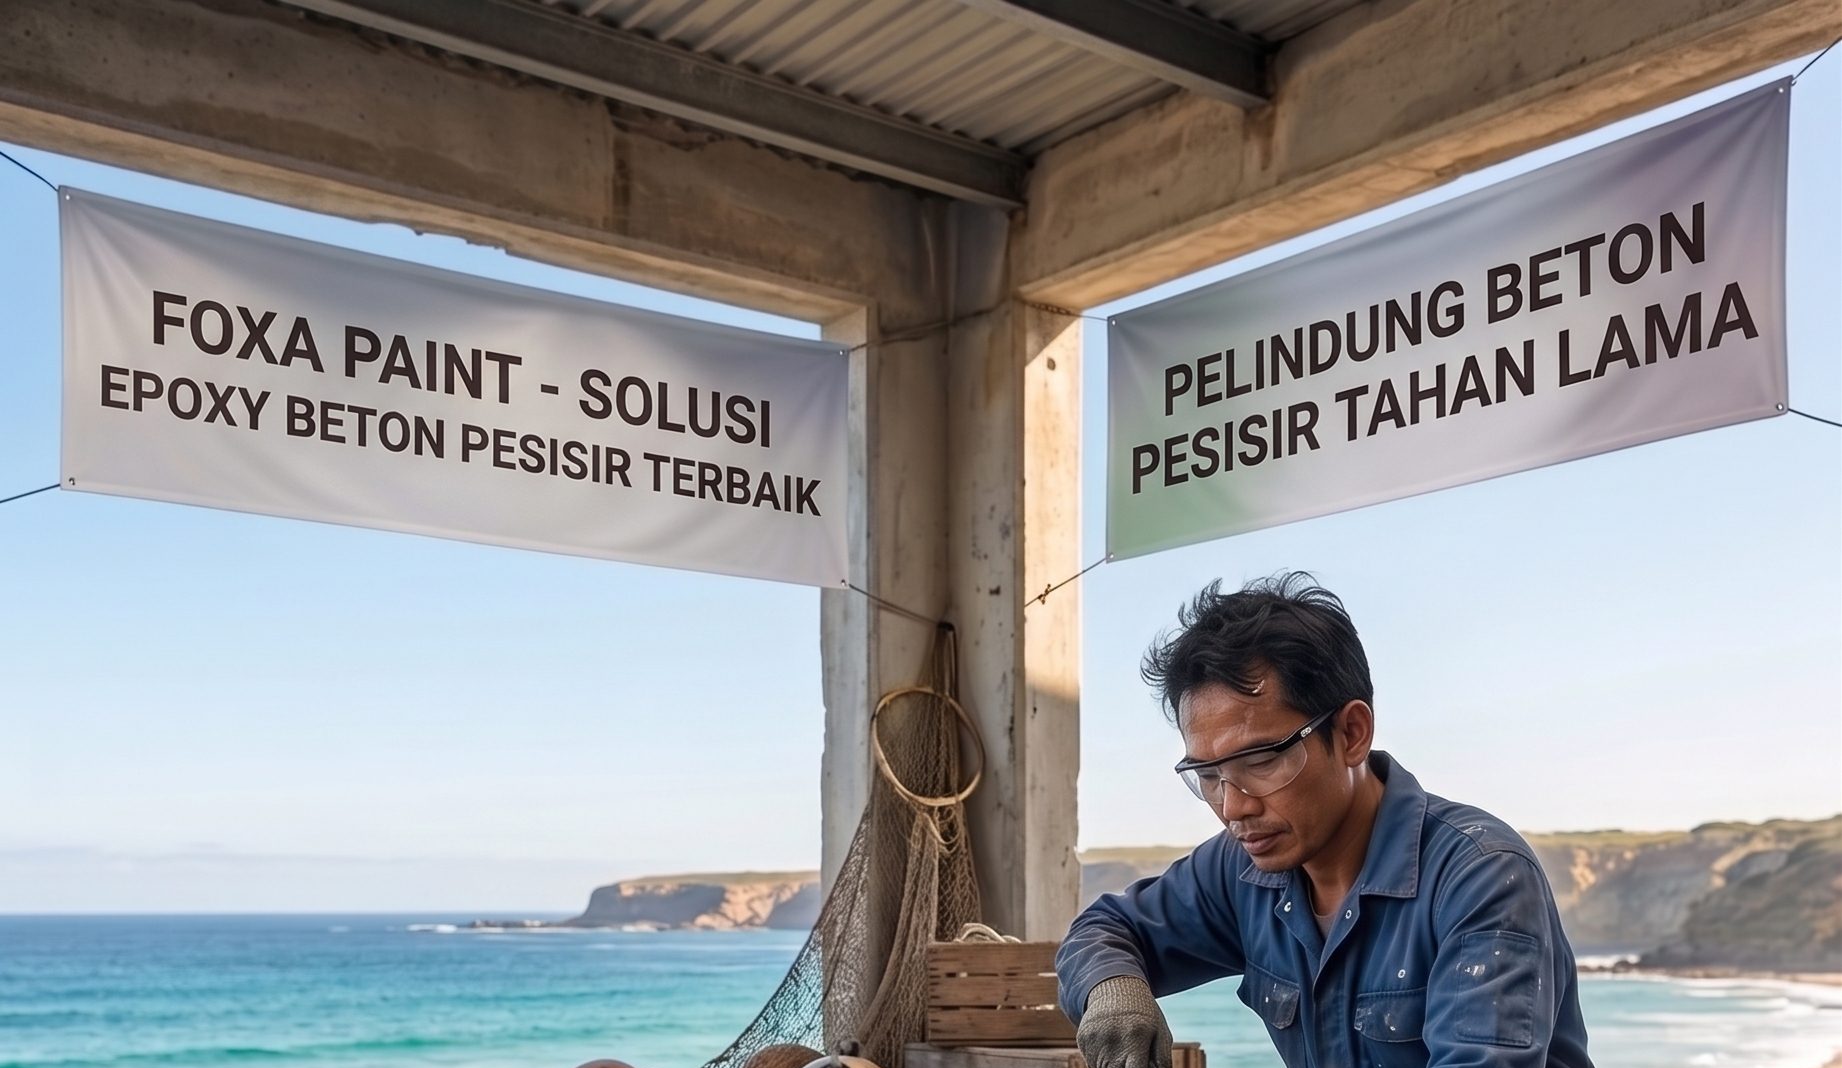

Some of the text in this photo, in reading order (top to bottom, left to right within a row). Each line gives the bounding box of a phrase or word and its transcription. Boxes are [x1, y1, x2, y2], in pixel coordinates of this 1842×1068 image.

[152, 290, 772, 448] FOXA PAINT - SOLUSI
[1131, 281, 1760, 494] PESISIR TAHAN LAMA
[1164, 202, 1706, 416] PELINDUNG BETON
[99, 365, 823, 517] EPOXY BETON PESISIR TERBAIK
